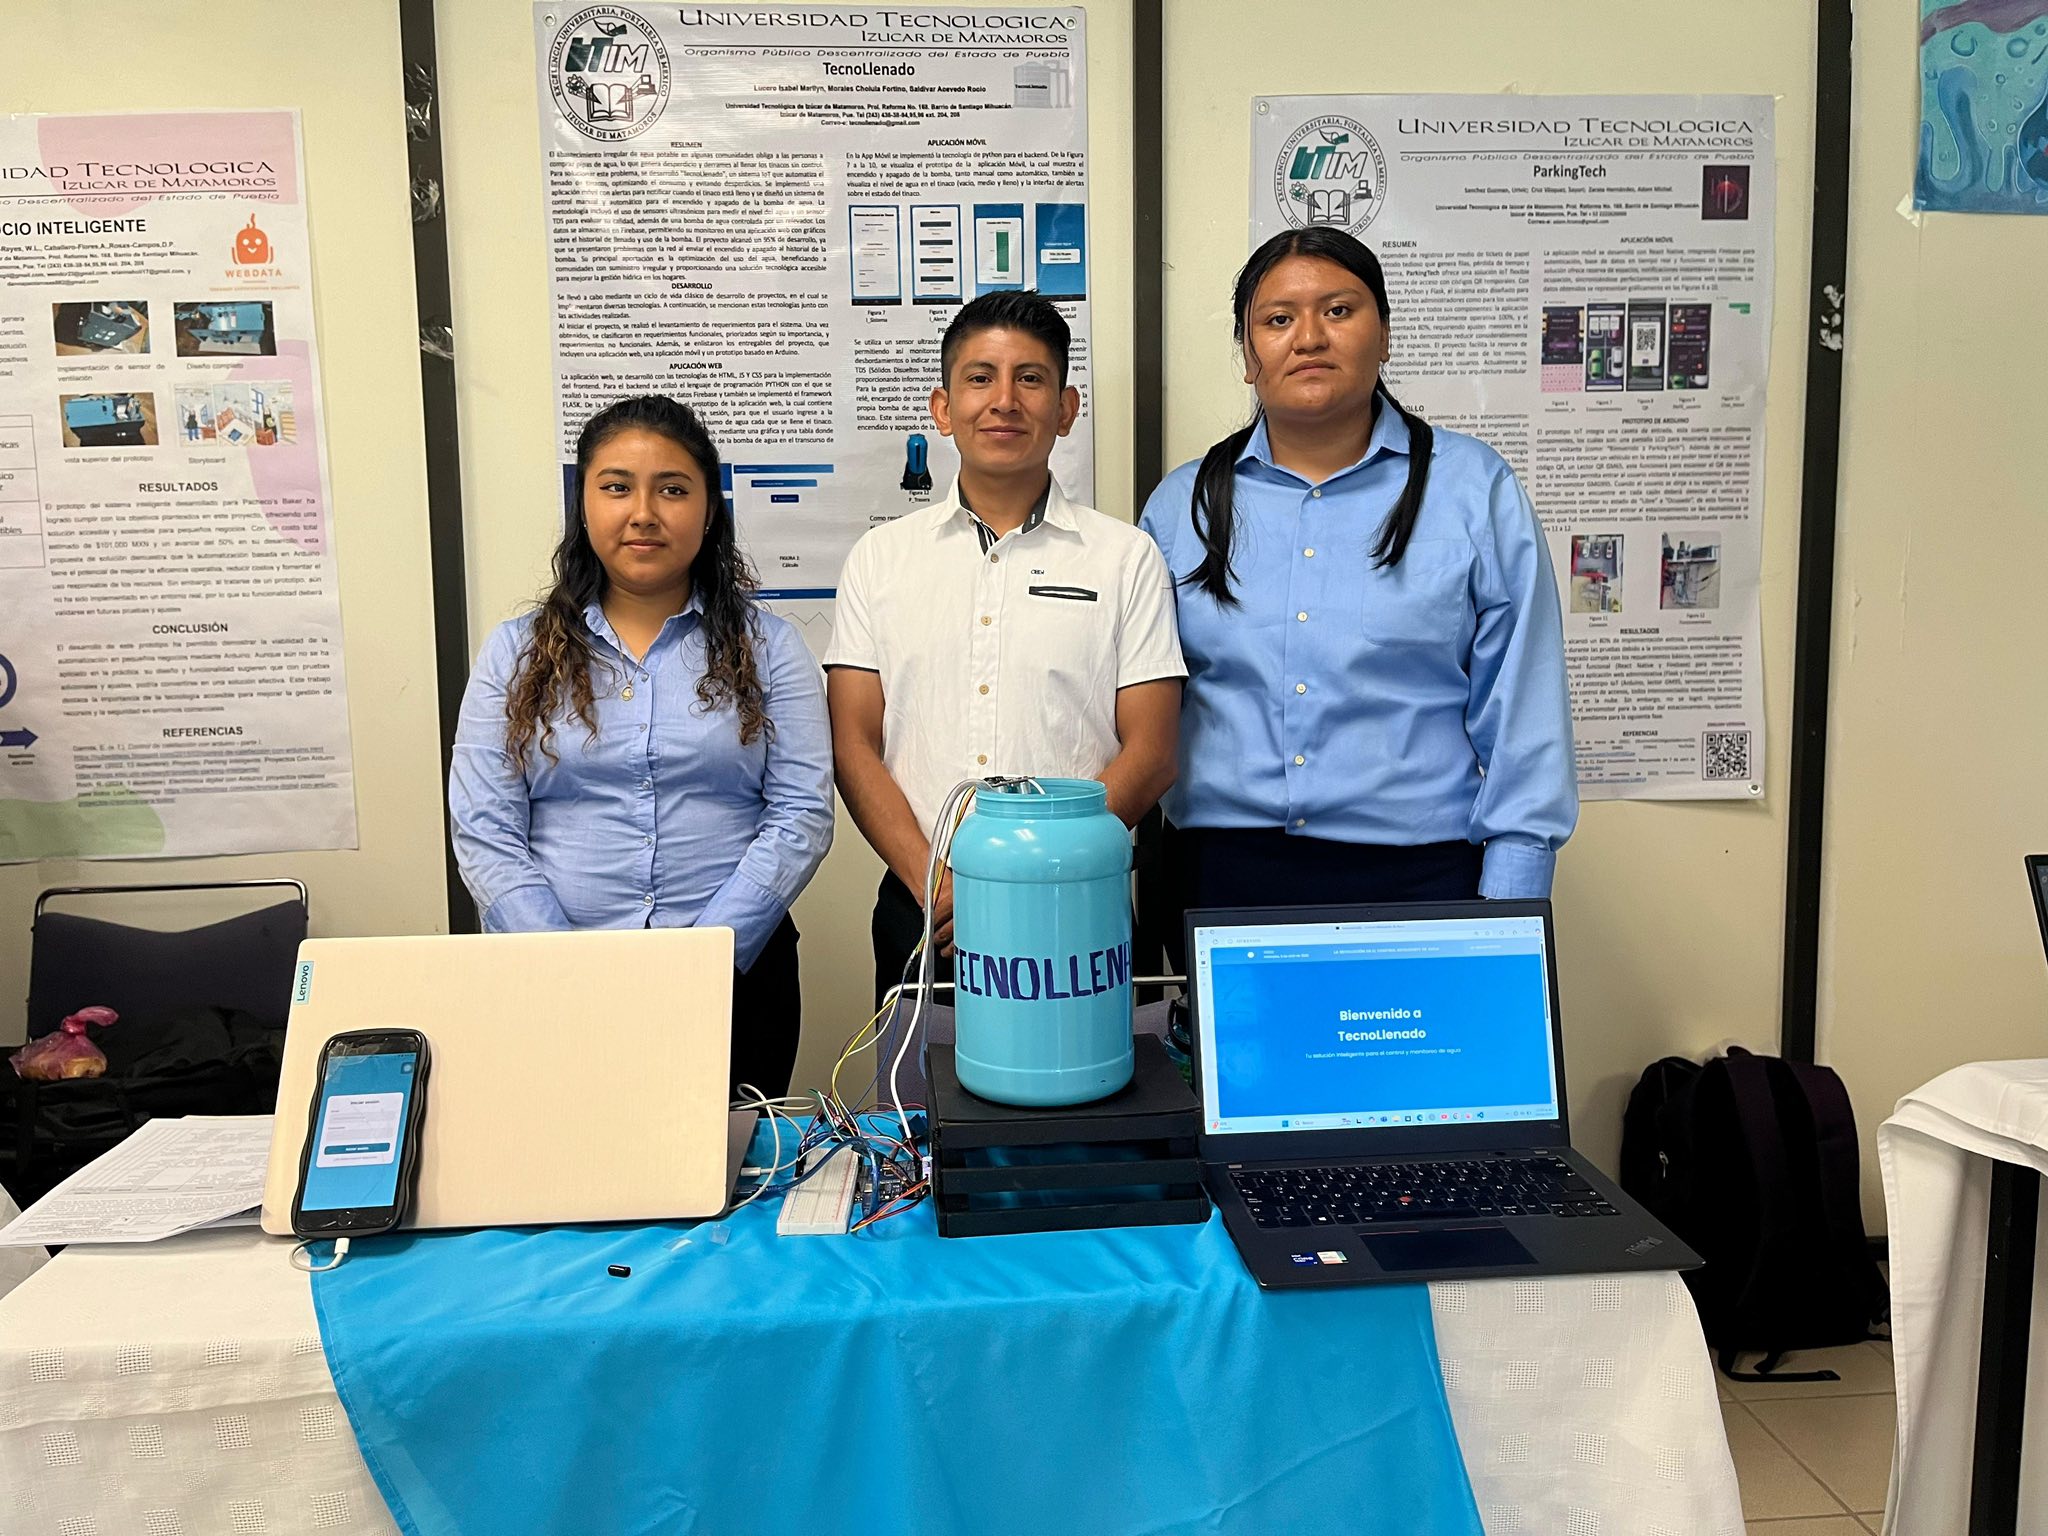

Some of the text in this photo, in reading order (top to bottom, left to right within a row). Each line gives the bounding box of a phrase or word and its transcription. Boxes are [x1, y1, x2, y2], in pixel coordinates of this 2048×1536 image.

[679, 10, 1070, 29] UNIVERSIDAD TECNOLOGICA
[862, 32, 1067, 44] IZUCAR DE MATAMOROS
[550, 7, 670, 96] EXCELENCIA UNIVERSITARIA, FORTALEZA DE MEXICO
[684, 46, 757, 57] Organismo
[816, 47, 923, 57] Descentralizado
[927, 48, 952, 58] del
[954, 48, 997, 58] Estado
[1002, 49, 1020, 58] de
[1025, 49, 1070, 58] Puebla
[823, 62, 915, 76] TecnoLlenado
[567, 112, 657, 139] IZUCAR DE MATAMOROS
[1398, 118, 1753, 134] UNIVERSIDAD TECNOLOGICA
[1564, 136, 1753, 147] IZUCAR DE MATAMOROS
[1276, 118, 1385, 202] EXCELENCIA UNIVERSITARIA, FORTALEZA DE MEXICO
[2, 159, 274, 179] IDAD TECNOLOGICA
[1533, 165, 1607, 180] ParkingTech
[62, 177, 276, 190] IZUCAR DE MATAMOROS
[17, 196, 125, 205] Descentralizado
[0, 219, 146, 236] CIO INTELIGENTE
[1349, 216, 1372, 235] MOROS
[225, 268, 283, 278] WEBDATA
[138, 482, 219, 492] RESULTADOS
[152, 622, 229, 634] CONCLUSIÓN
[162, 726, 243, 737] REFERENCIAS
[954, 941, 1131, 1000] ECNOLLENA
[297, 965, 310, 1002] Lenovo
[1340, 1008, 1422, 1021] Bienvenido a
[1338, 1028, 1427, 1042] TecnoLlenado
